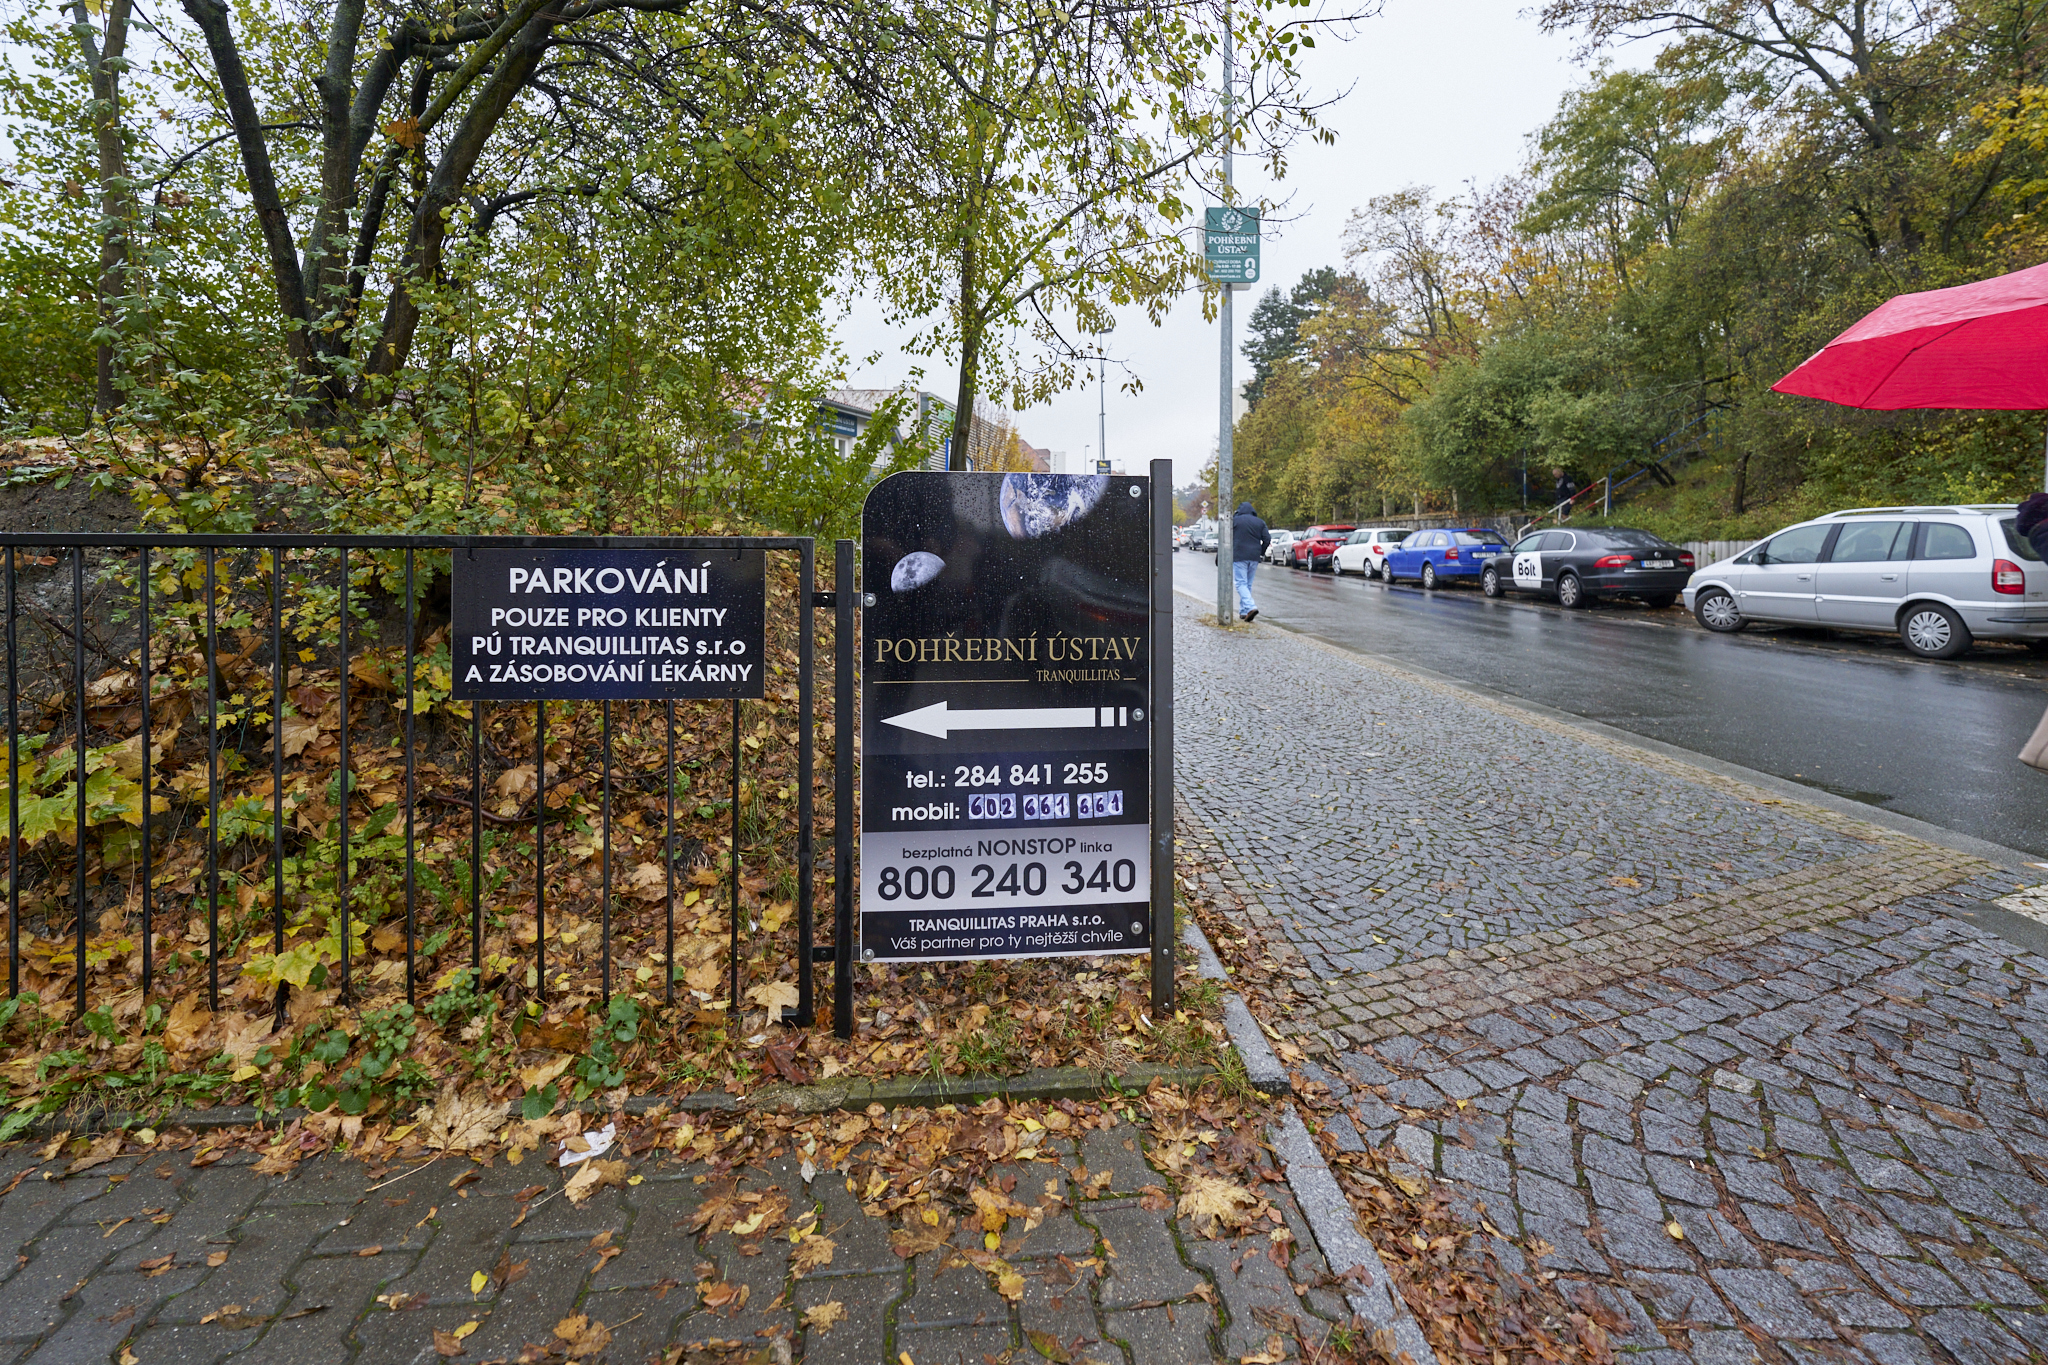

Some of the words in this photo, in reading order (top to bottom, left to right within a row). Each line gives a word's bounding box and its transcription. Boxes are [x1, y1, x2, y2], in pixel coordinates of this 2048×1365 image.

[1208, 235, 1256, 244] POHŘEBNÍ
[510, 560, 711, 593] PARKOVÁNÍ
[1518, 562, 1536, 576] Bolt
[492, 608, 569, 626] POUZE
[578, 608, 627, 626] PRO
[636, 608, 727, 626] KLIENTY
[473, 631, 501, 655] PÚ
[509, 636, 689, 655] TRANQUILLITAS
[696, 640, 745, 655] s.r.o
[875, 631, 1037, 662] POHŘEBNÍ
[1047, 631, 1140, 660] ÚSTAV
[465, 665, 483, 682] A
[490, 659, 645, 682] ZÁSOBOVÁNÍ
[652, 659, 752, 681] LÉKÁRNY
[1036, 669, 1120, 683] TRANQUILLITAS
[906, 771, 945, 788] tel.:
[955, 765, 1001, 786] 284
[1010, 764, 1051, 785] 841
[1064, 763, 1108, 784] 255
[891, 801, 961, 821] mobil:
[903, 846, 972, 860] bezplatná
[978, 838, 1076, 856] NONSTOP
[1081, 842, 1112, 852] linka
[878, 865, 955, 900] 800
[971, 862, 1046, 897] 240
[1062, 859, 1135, 894] 340
[909, 916, 1015, 931] TRANQUILLITAS
[1020, 914, 1068, 928] PRAHA
[1072, 915, 1104, 926] s.r.o.
[891, 937, 916, 949] Váš
[921, 936, 975, 951] partner
[980, 937, 1004, 949] pro
[1008, 934, 1021, 948] ty
[1026, 931, 1078, 947] nejtěžší
[1082, 930, 1123, 943] chvíle
